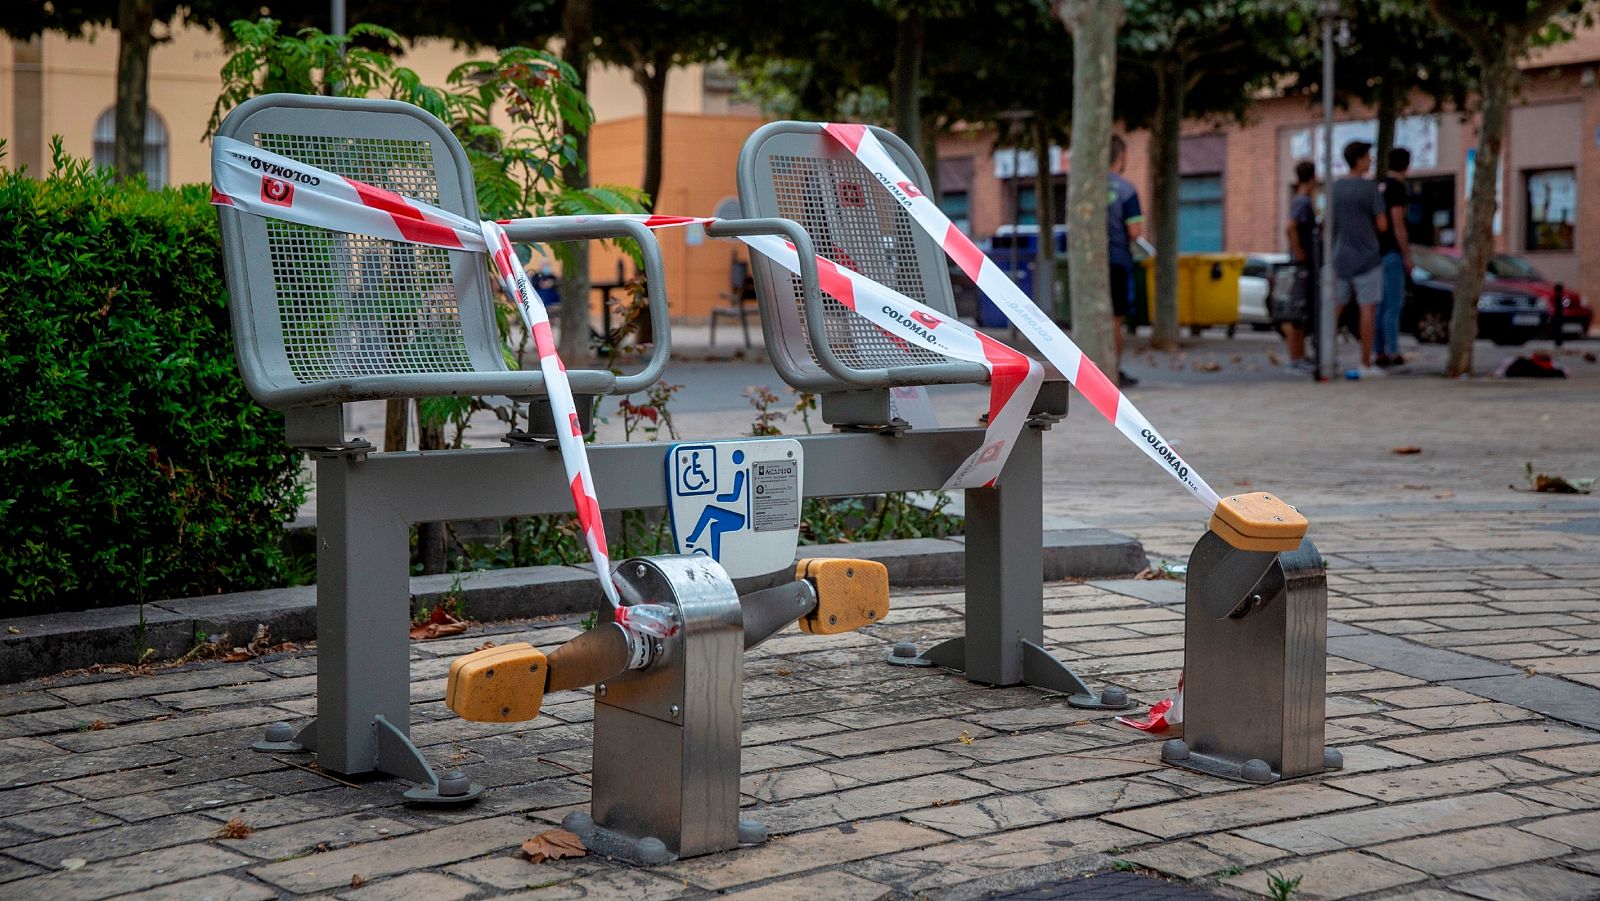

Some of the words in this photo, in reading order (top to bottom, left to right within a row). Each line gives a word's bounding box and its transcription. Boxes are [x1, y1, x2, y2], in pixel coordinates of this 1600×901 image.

[247, 156, 321, 186] COLOMAQ,
[881, 305, 937, 346] COLOMAQ,
[1140, 428, 1188, 482] COLOMAQ,
